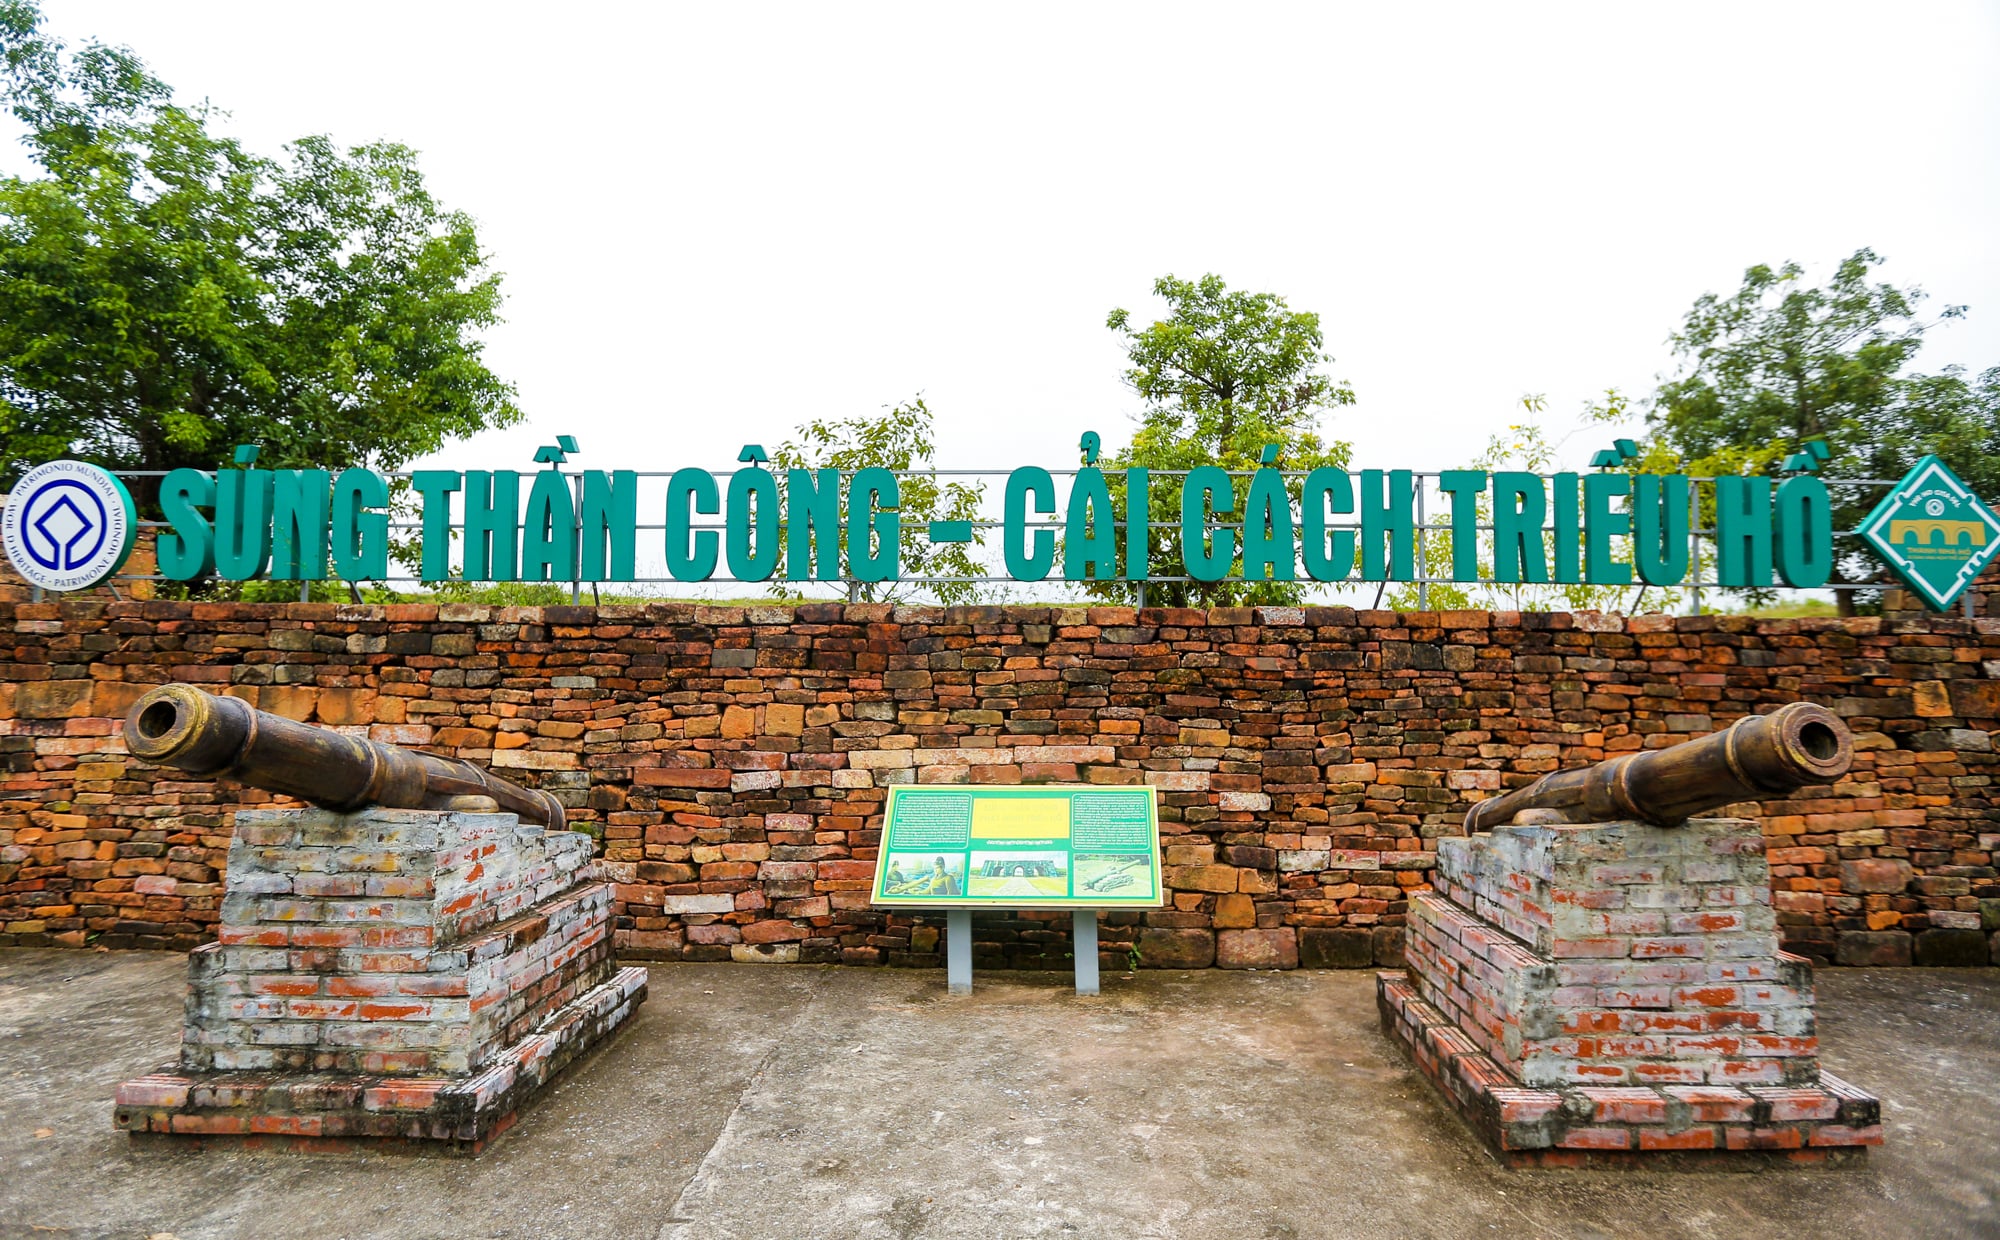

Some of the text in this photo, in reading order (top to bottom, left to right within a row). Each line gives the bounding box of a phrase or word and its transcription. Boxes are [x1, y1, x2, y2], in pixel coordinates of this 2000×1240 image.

[16, 463, 114, 499] PATRIMONIO MUNDIAL
[157, 444, 390, 580] SÚNG
[412, 435, 637, 582] THẦN
[665, 444, 900, 583] CÔNG
[1004, 430, 1149, 582] CẢI
[1182, 443, 1414, 583] CÁCH
[1440, 439, 1690, 586] TRIỀU
[1717, 441, 1832, 588] HỒ
[54, 507, 122, 587] PATRIMOINE MONDIAL
